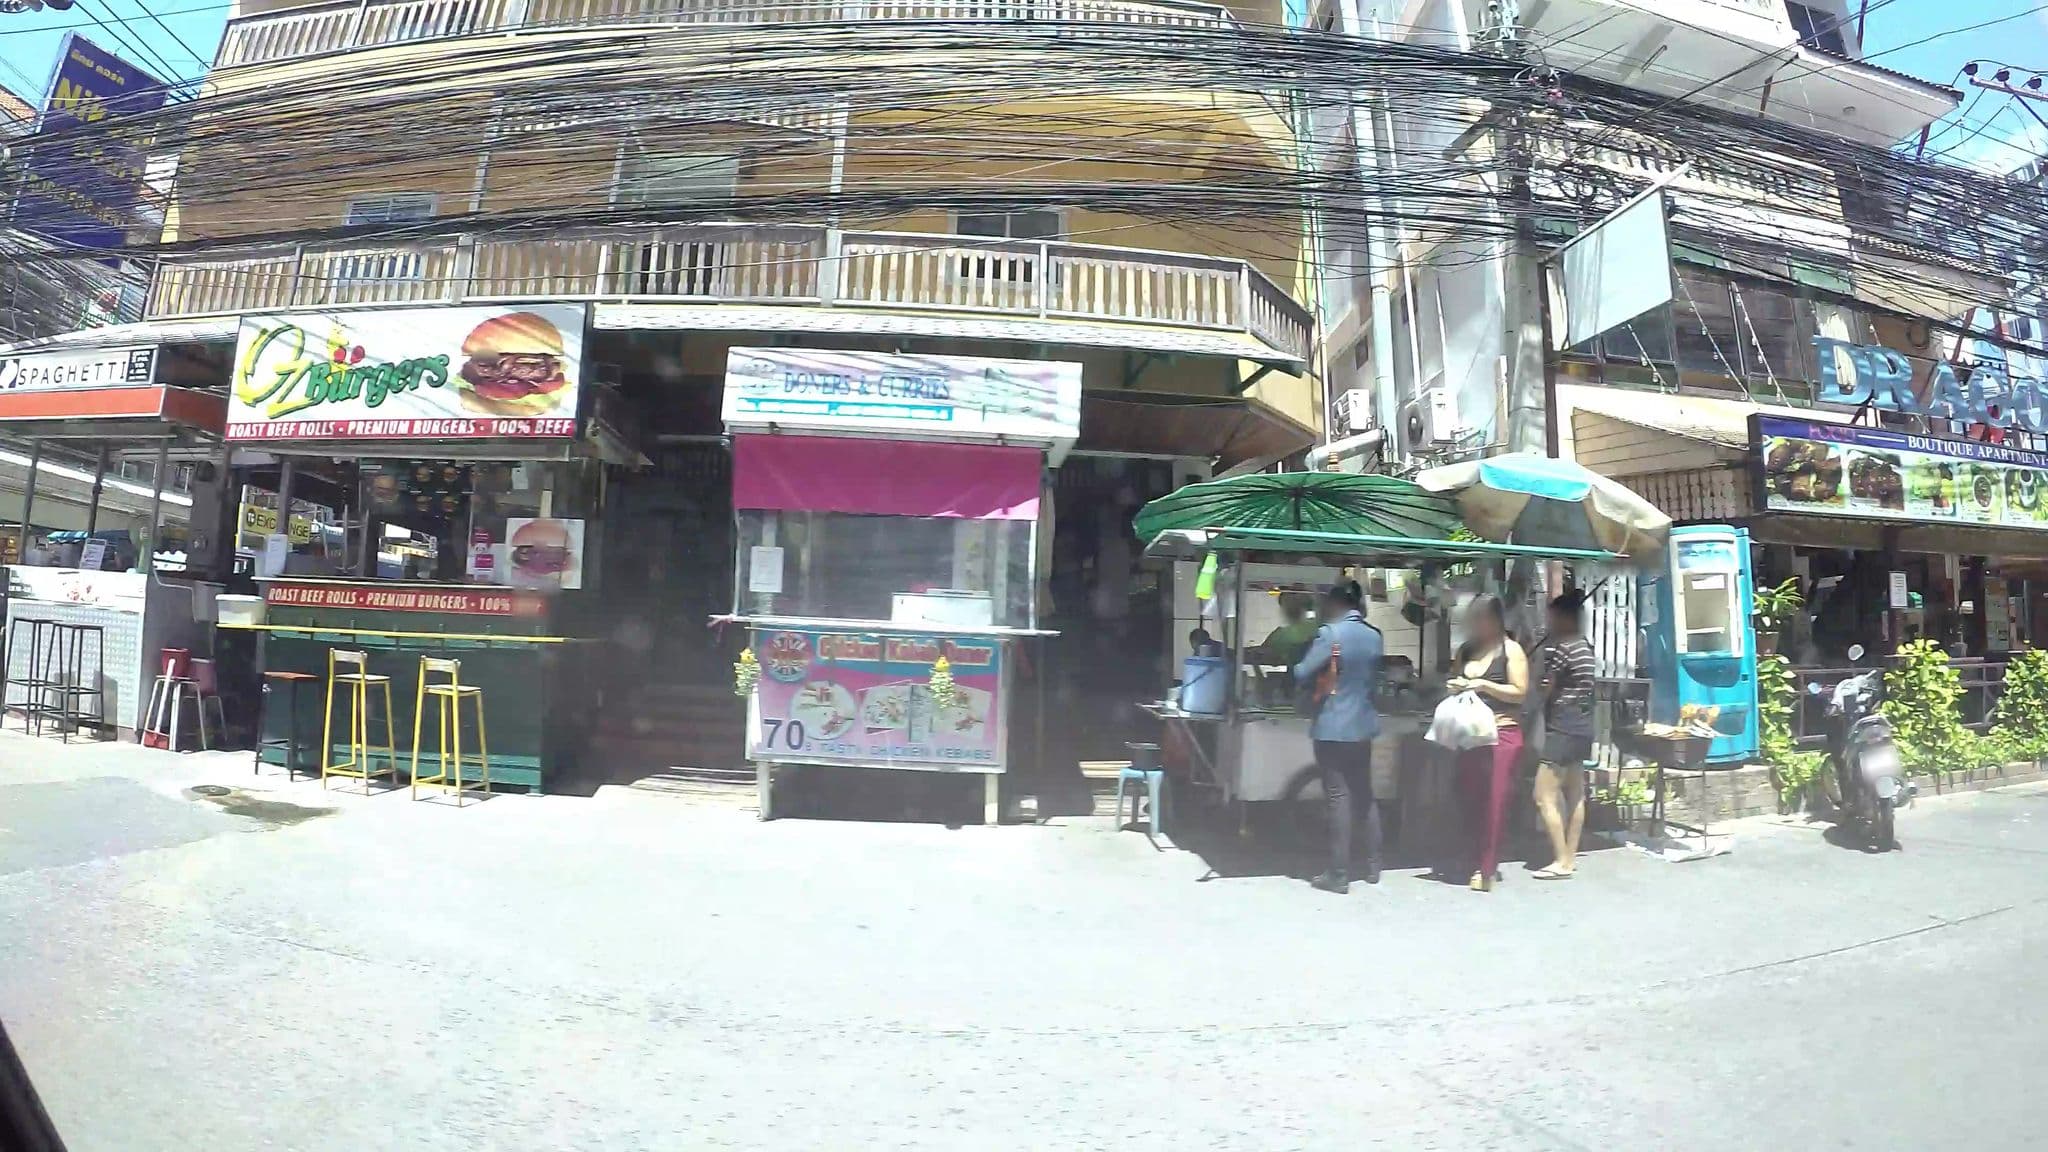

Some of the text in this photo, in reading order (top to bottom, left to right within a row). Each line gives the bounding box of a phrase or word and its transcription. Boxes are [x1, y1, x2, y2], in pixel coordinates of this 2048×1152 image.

[18, 361, 127, 386] SPAGHETTI
[306, 354, 449, 408] Burgers
[229, 419, 572, 437] ROAST BEEF ROLLS PREMIUM BURGERS 100% BEEF
[1908, 436, 2046, 466] BOUTIQUE APARTMENT
[268, 587, 297, 603] ROAST
[300, 588, 325, 603] BEEF
[327, 589, 357, 605] ROLLS
[366, 591, 415, 608] PREMIUM
[417, 593, 467, 610] BURGERS
[479, 596, 512, 611] 100%
[764, 718, 805, 751] 70
